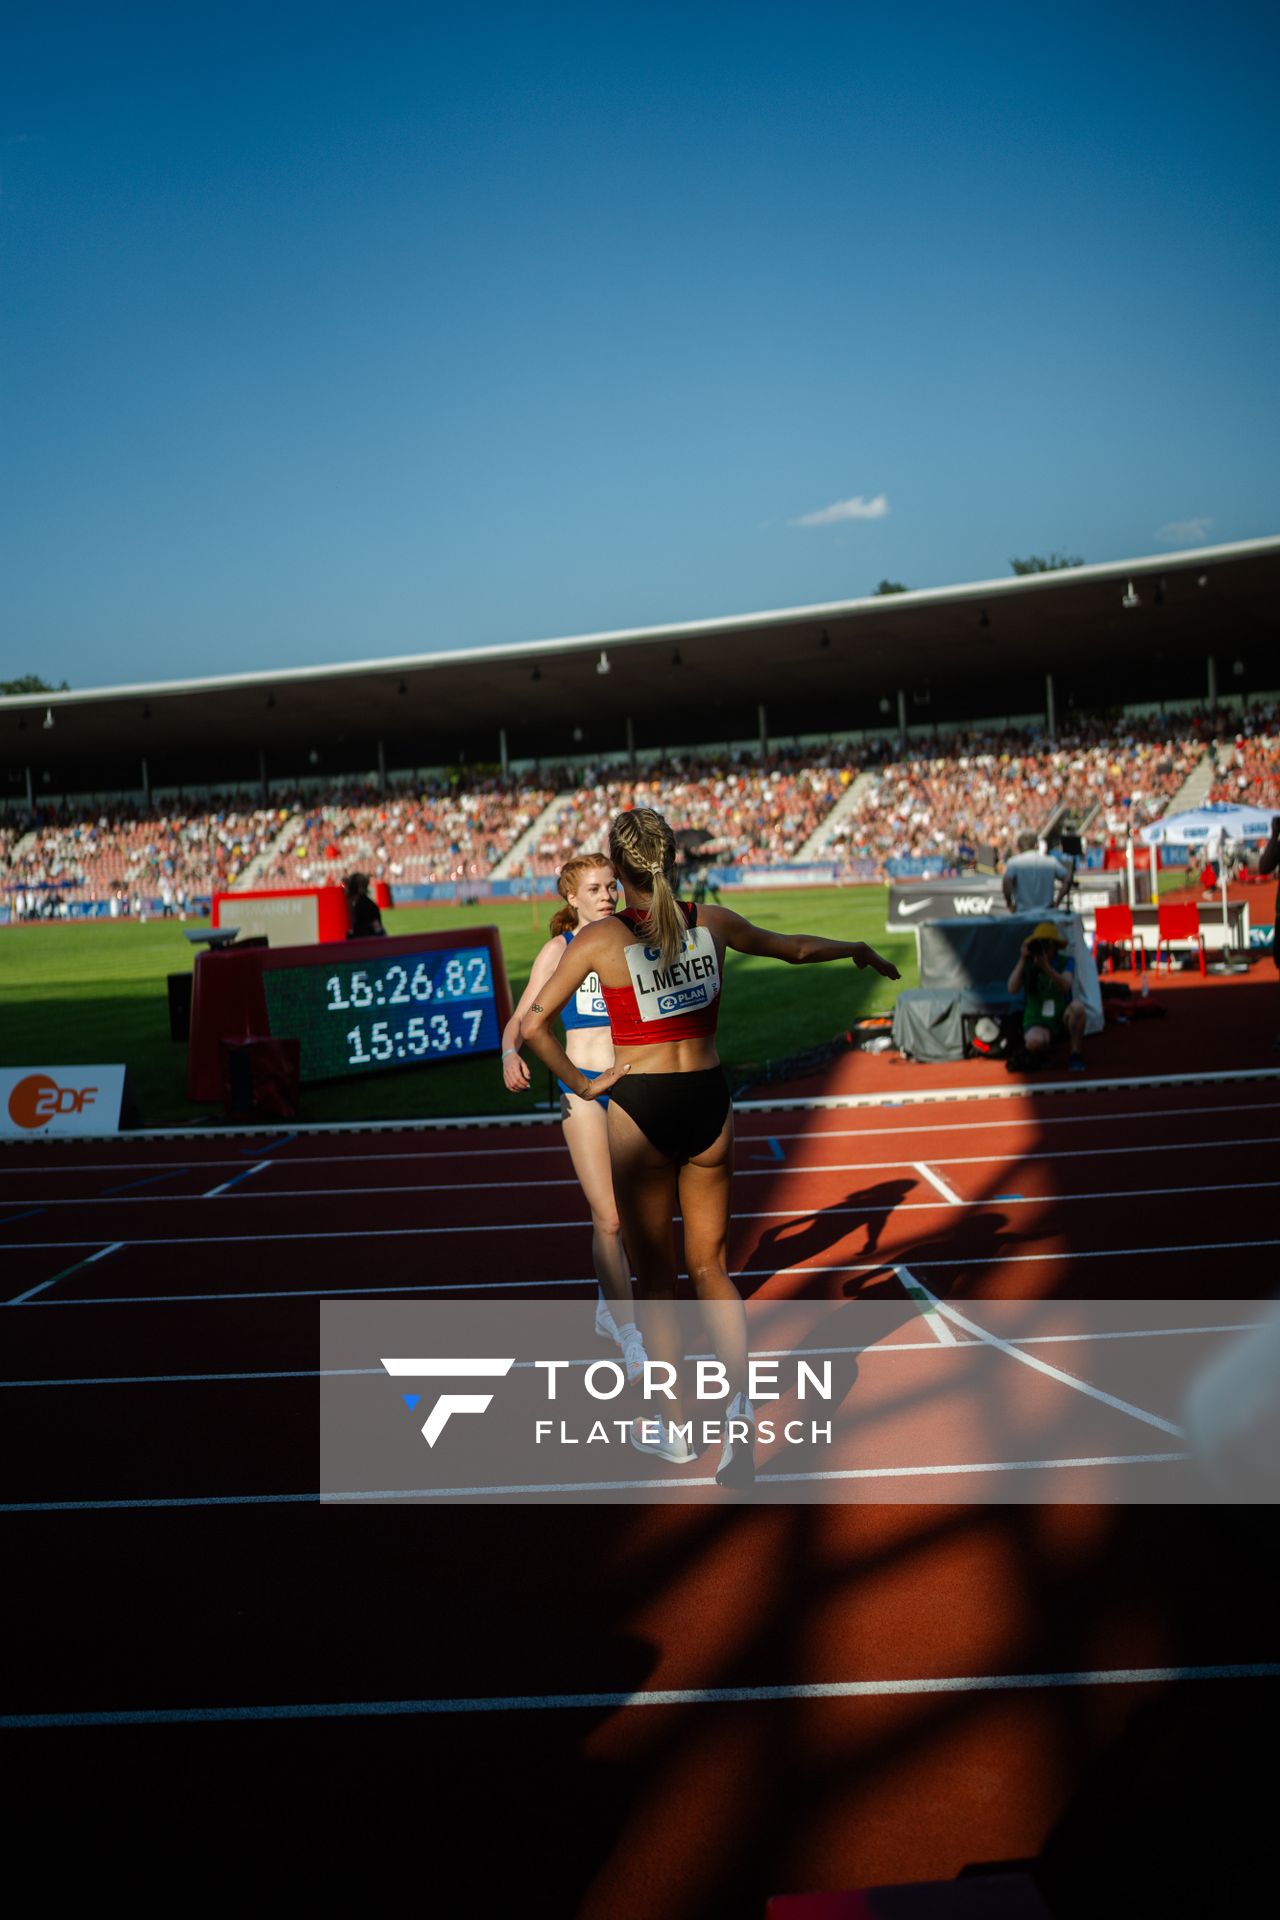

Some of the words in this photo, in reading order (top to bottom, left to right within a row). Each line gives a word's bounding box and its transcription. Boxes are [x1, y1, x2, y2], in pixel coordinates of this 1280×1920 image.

[636, 955, 716, 995] L.MEYER
[678, 987, 705, 1003] PLAN
[346, 1009, 484, 1064] 15:53.7
[35, 1087, 99, 1116] ZDF
